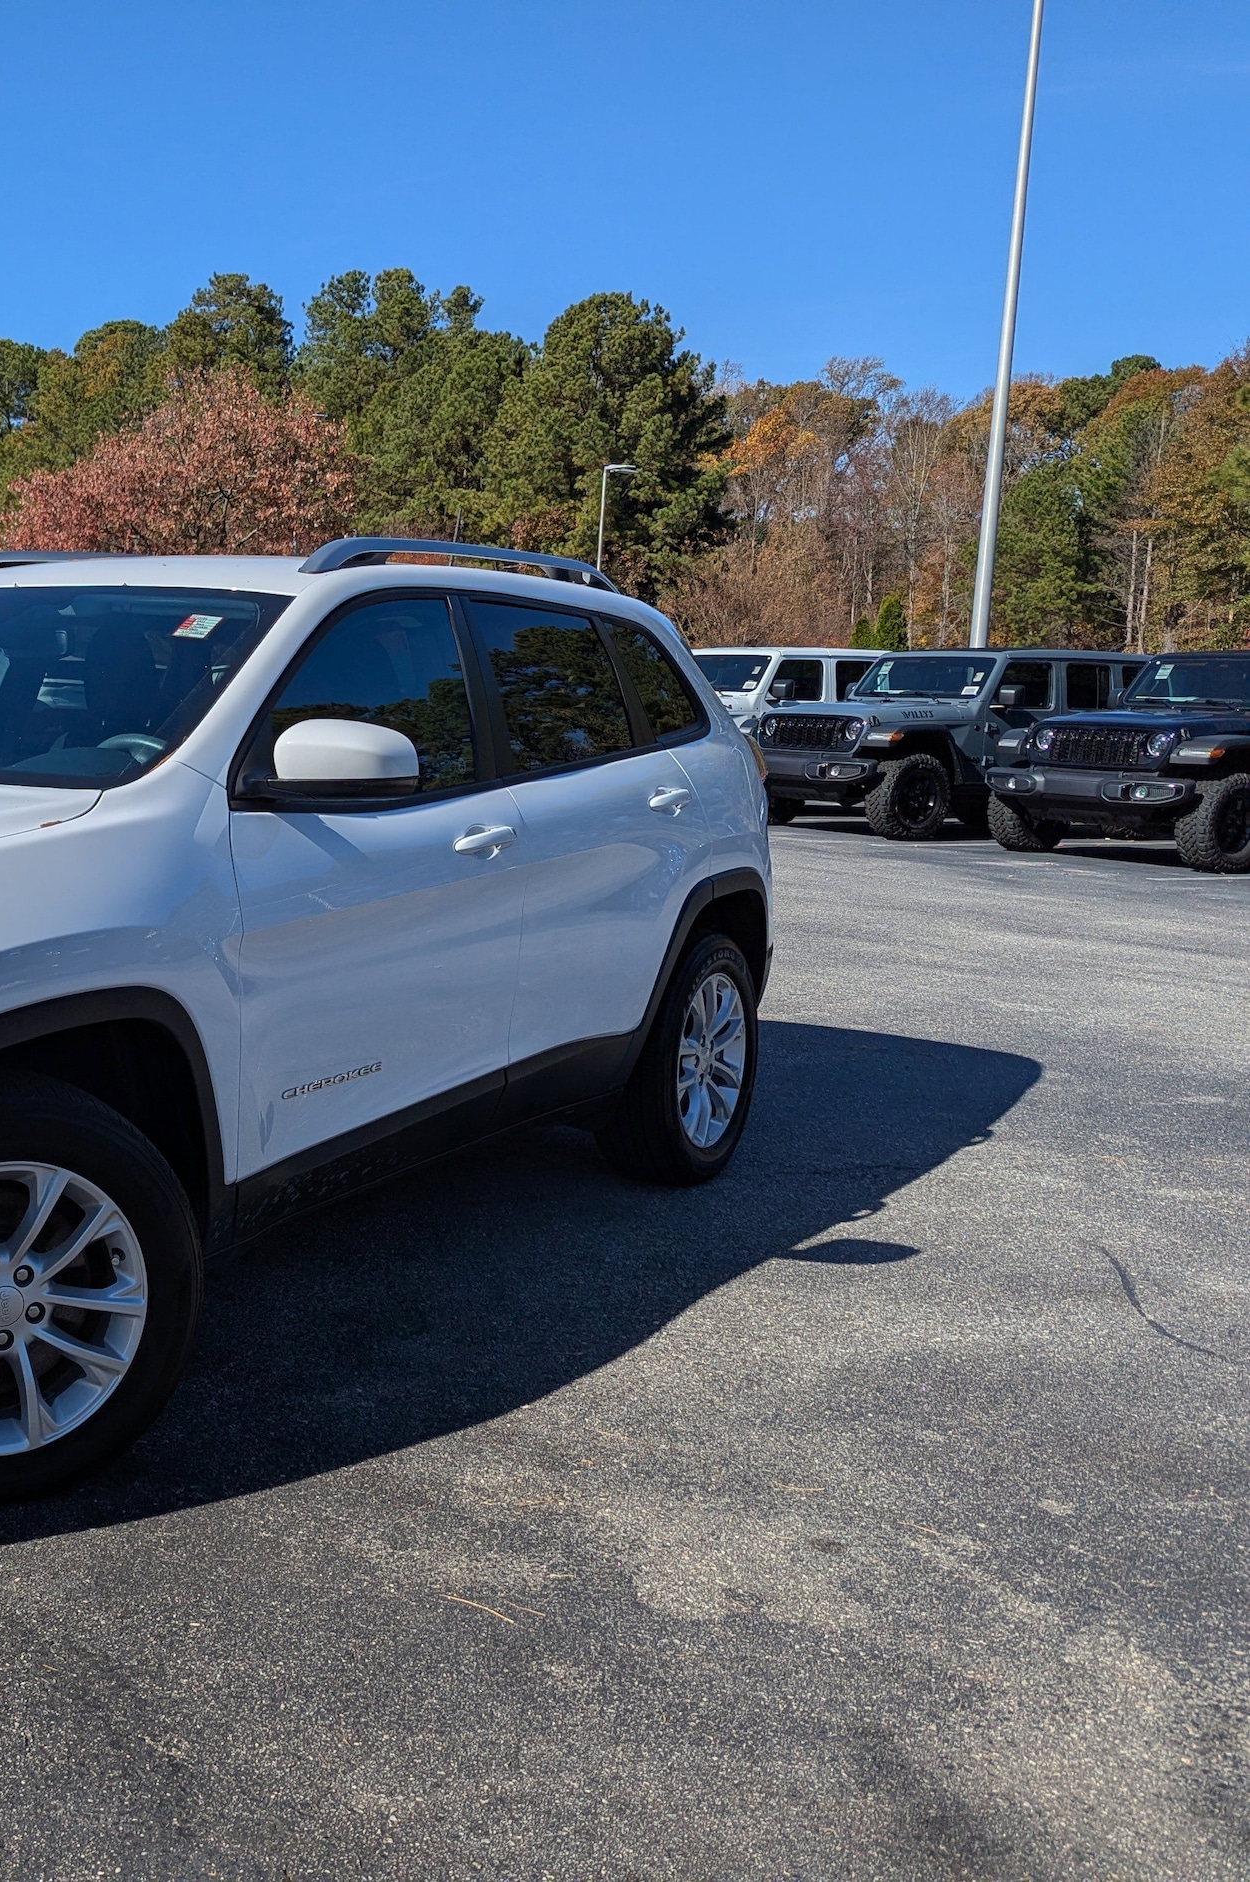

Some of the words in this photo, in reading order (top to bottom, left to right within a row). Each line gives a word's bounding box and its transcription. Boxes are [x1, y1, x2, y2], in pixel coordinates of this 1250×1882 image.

[901, 710, 934, 719] WILLYS
[281, 1061, 383, 1100] CHEROKEE
[0, 1290, 12, 1322] Jeep
